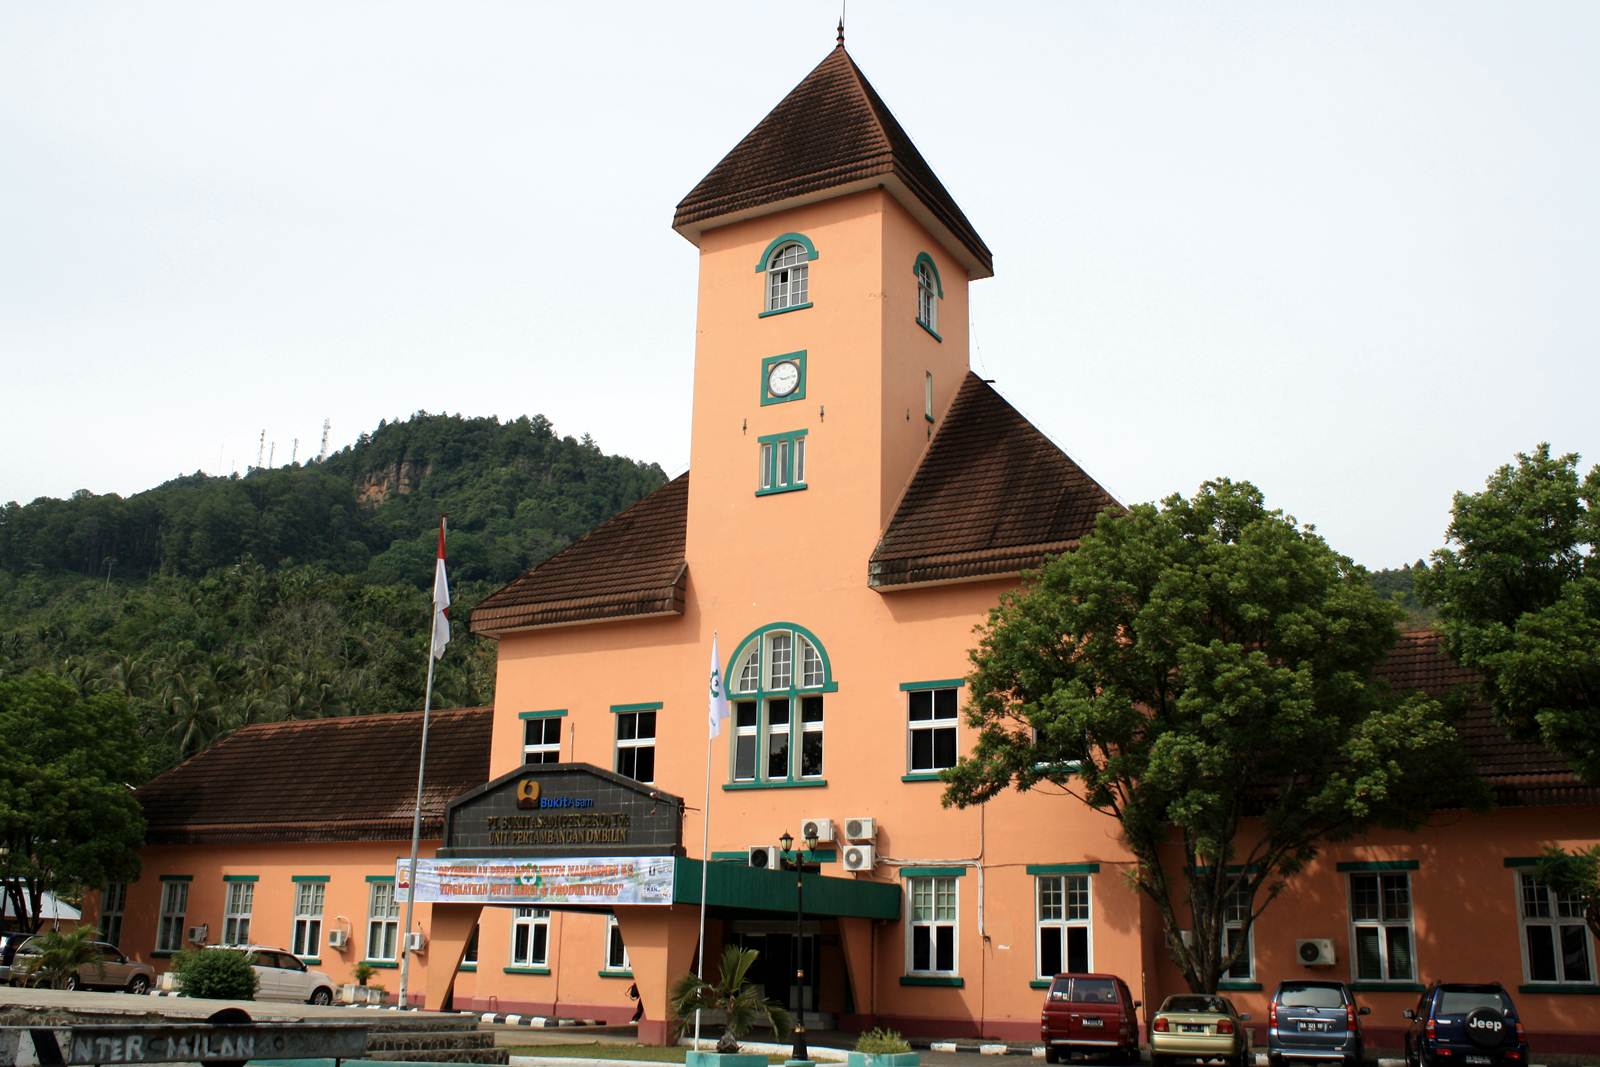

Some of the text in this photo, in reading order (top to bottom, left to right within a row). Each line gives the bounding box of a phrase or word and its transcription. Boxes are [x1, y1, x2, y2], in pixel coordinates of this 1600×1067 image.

[488, 828, 627, 845] UNIT PERTAMBANGAN OMBILIN
[1469, 1017, 1502, 1032] Jeep
[167, 1033, 255, 1060] MILAN
